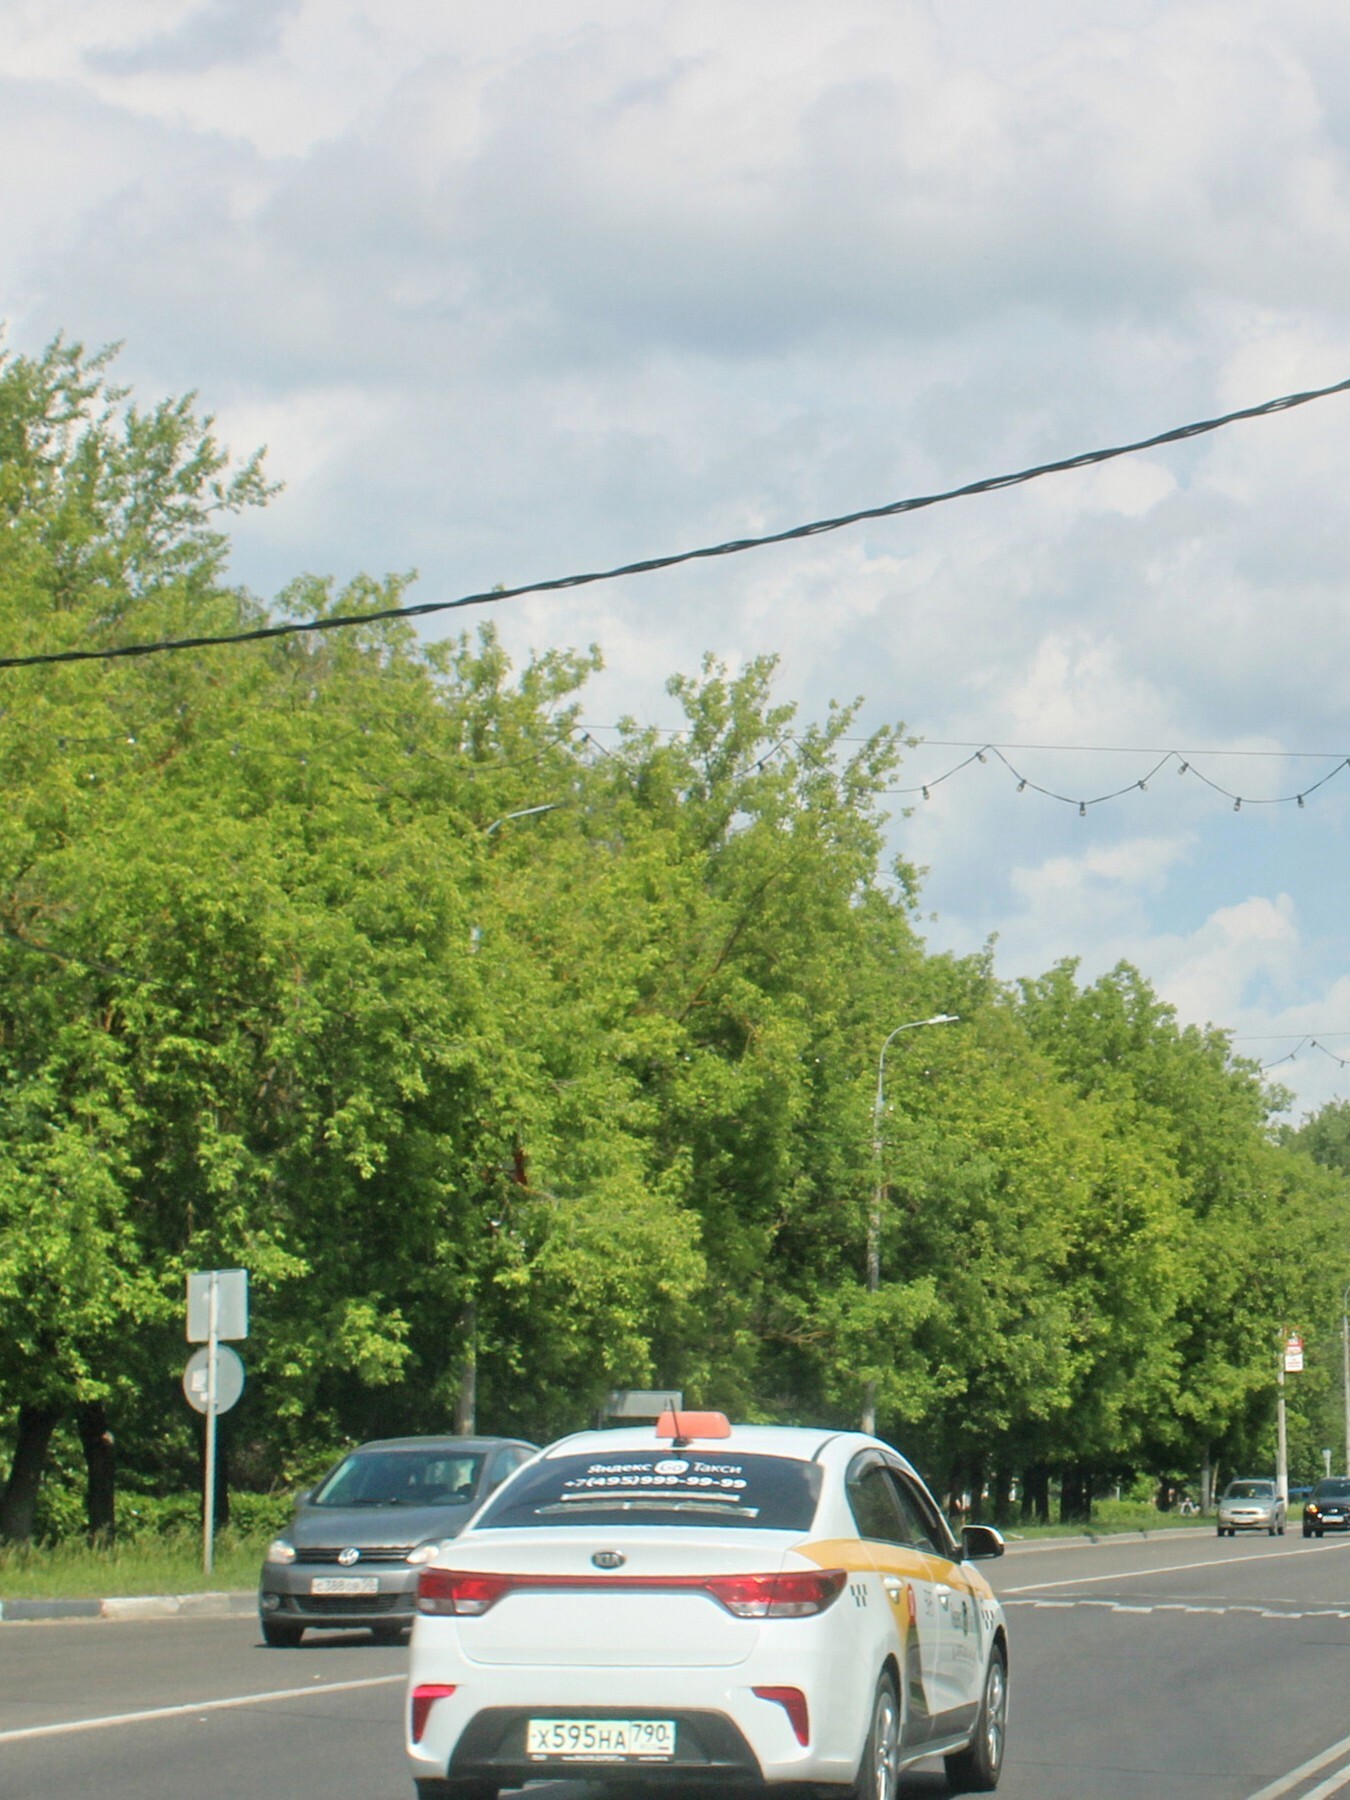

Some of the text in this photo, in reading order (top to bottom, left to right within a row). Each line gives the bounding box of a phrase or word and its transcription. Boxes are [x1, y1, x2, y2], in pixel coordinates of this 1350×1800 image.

[587, 1463, 652, 1474] Яндекс
[693, 1462, 742, 1474] Такси
[632, 1724, 666, 1742] 790
